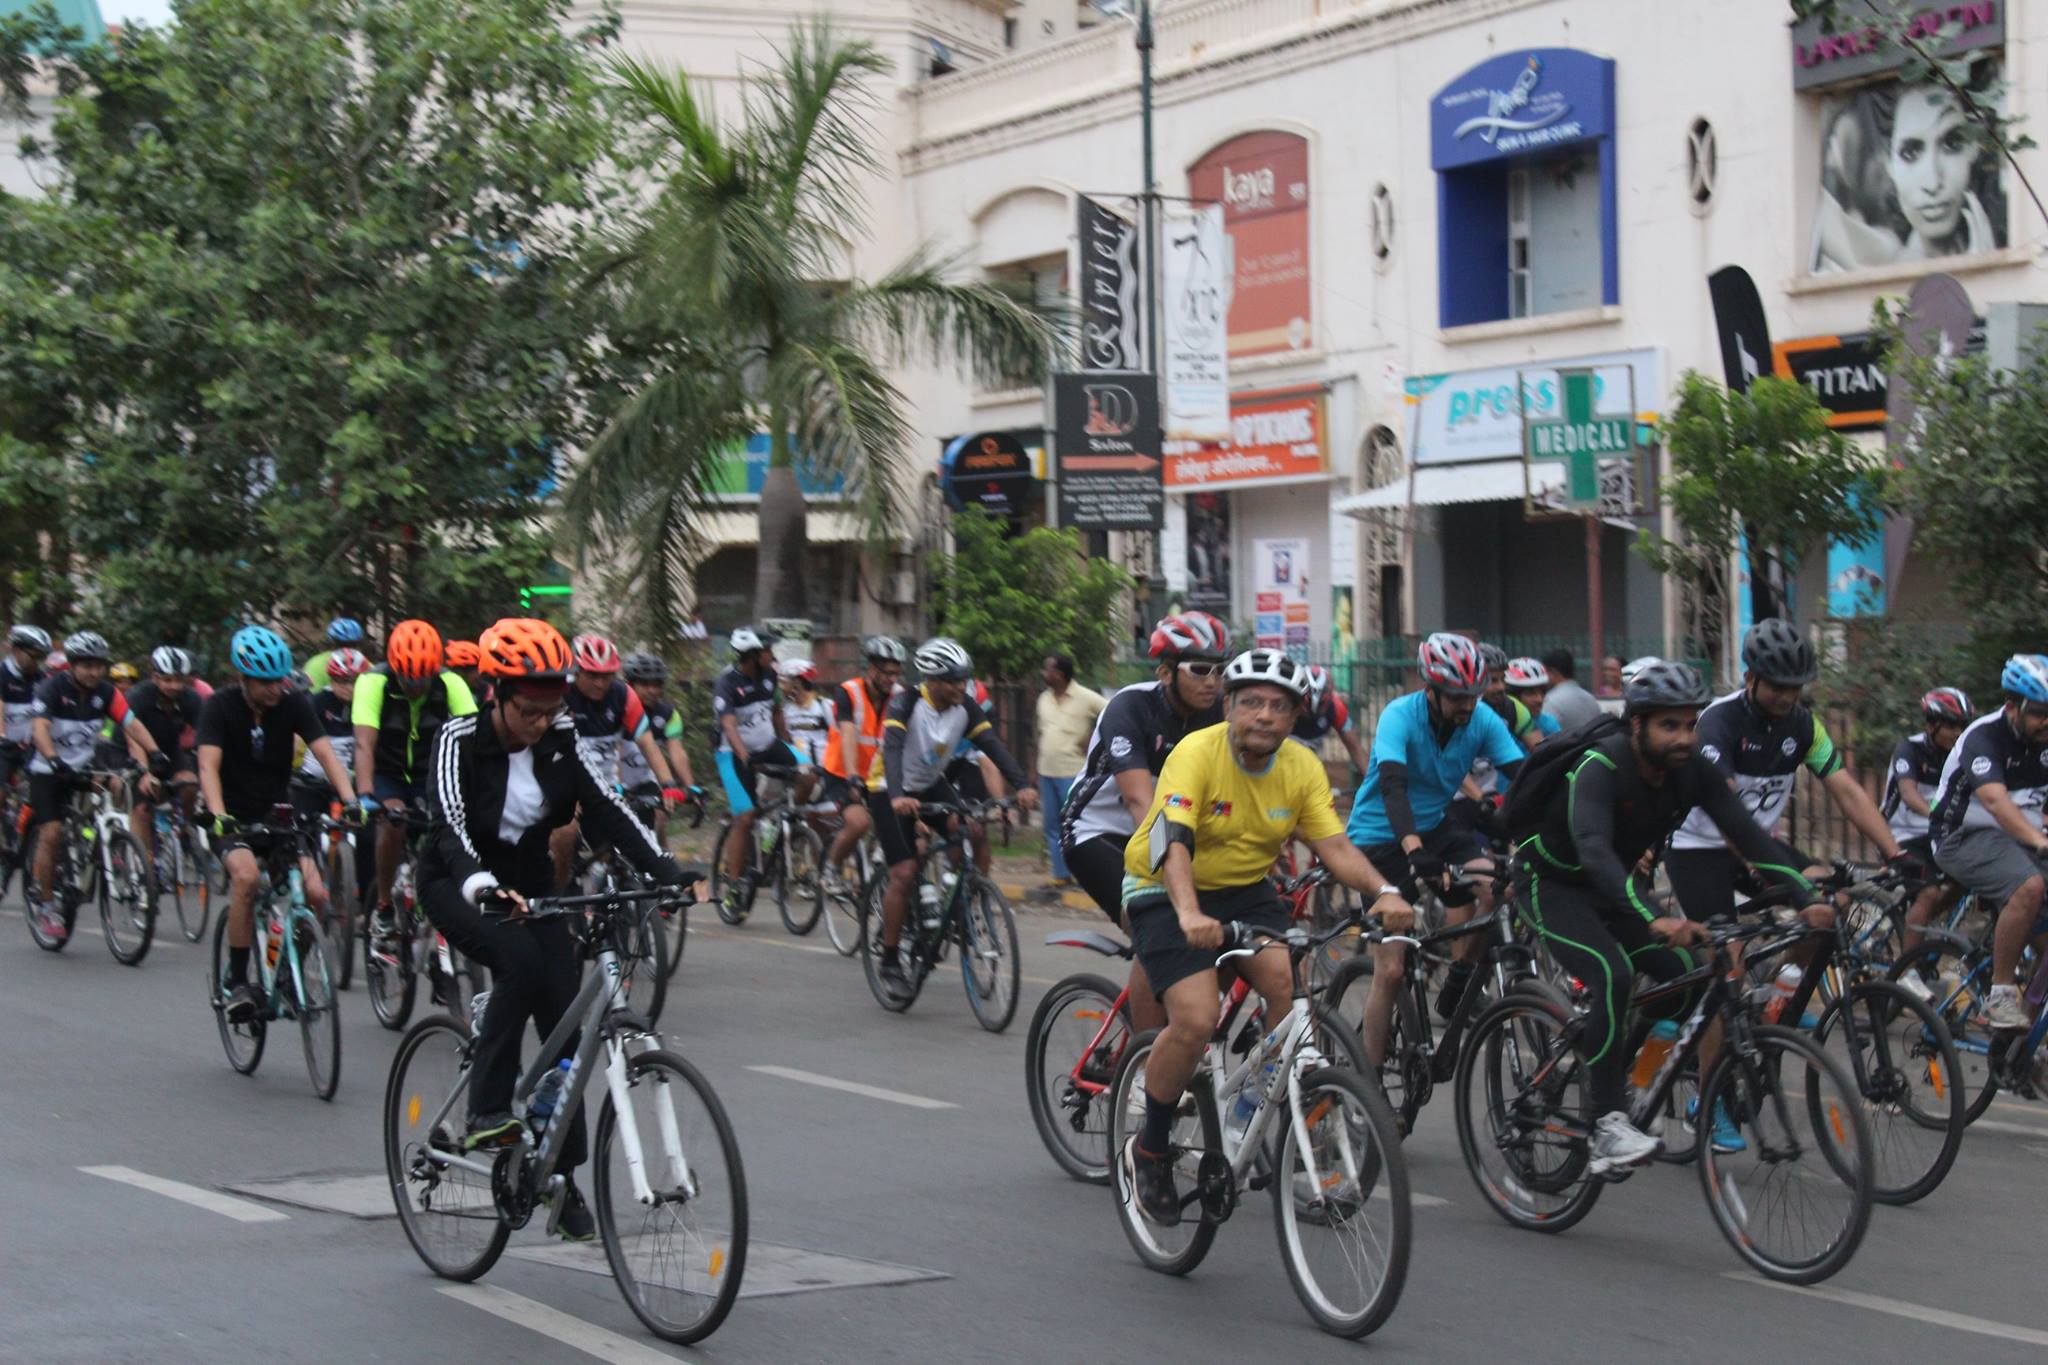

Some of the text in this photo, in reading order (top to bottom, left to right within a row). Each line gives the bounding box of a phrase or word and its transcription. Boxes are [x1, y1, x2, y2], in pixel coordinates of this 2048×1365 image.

[1223, 166, 1275, 206] kaya
[1804, 363, 1887, 396] TITAN
[1535, 421, 1626, 453] MEDICAL
